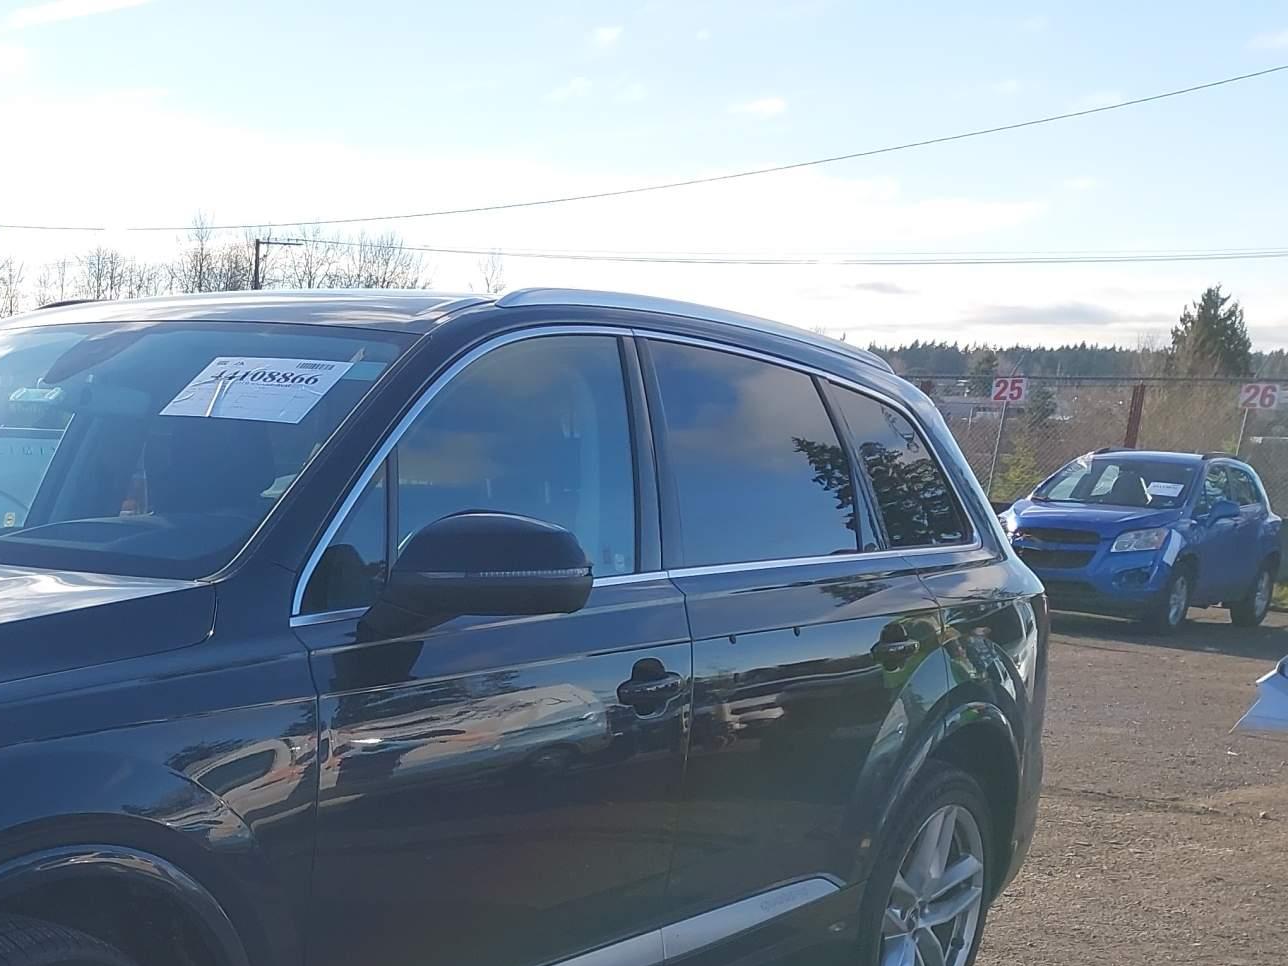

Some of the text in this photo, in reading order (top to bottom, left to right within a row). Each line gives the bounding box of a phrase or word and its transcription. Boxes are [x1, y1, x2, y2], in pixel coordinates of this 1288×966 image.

[210, 368, 322, 386] 44108866
[993, 379, 1023, 401] 25
[1242, 384, 1277, 408] 26
